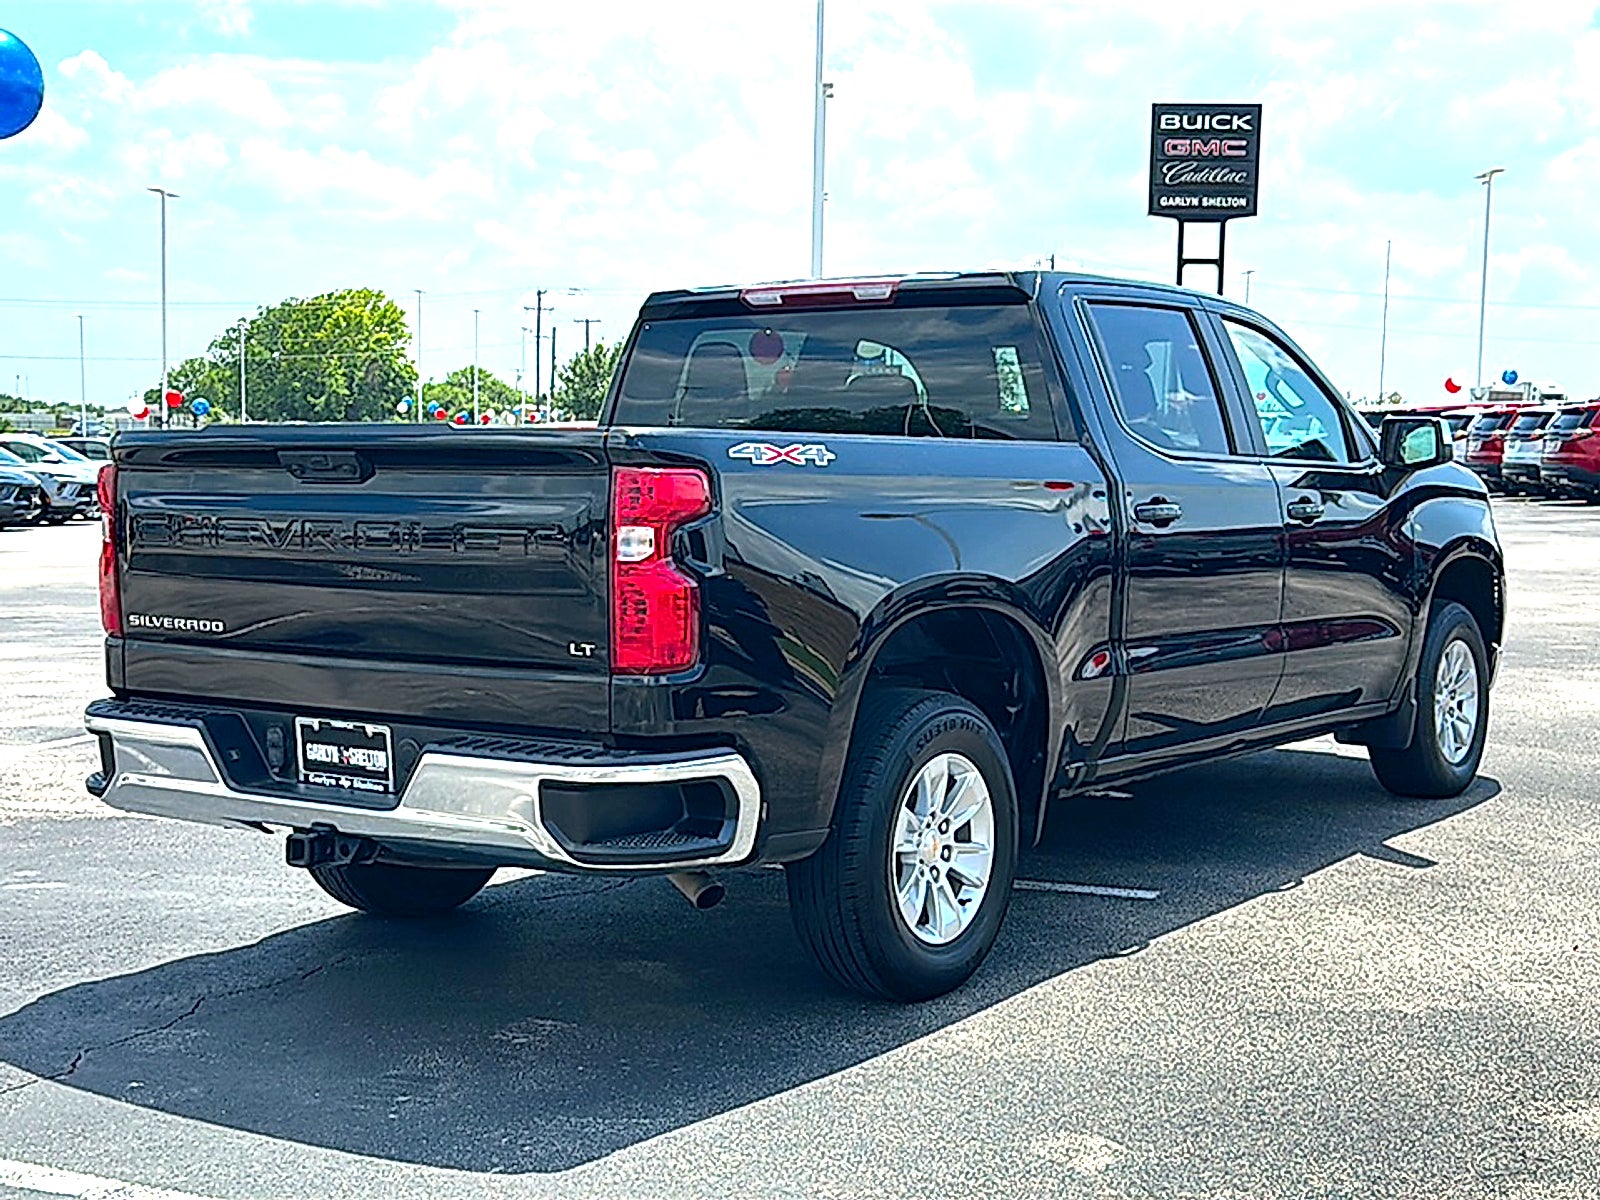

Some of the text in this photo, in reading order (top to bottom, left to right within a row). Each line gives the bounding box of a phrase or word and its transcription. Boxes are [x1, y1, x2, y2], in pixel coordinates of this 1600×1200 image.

[1160, 114, 1253, 130] BUICK
[1164, 139, 1247, 156] GMC
[1162, 161, 1247, 185] Cadillac
[1160, 197, 1247, 207] GARLYN SHELTON
[134, 512, 565, 556] CHEVROLET
[128, 614, 224, 632] SILVERADO
[569, 643, 596, 656] LT
